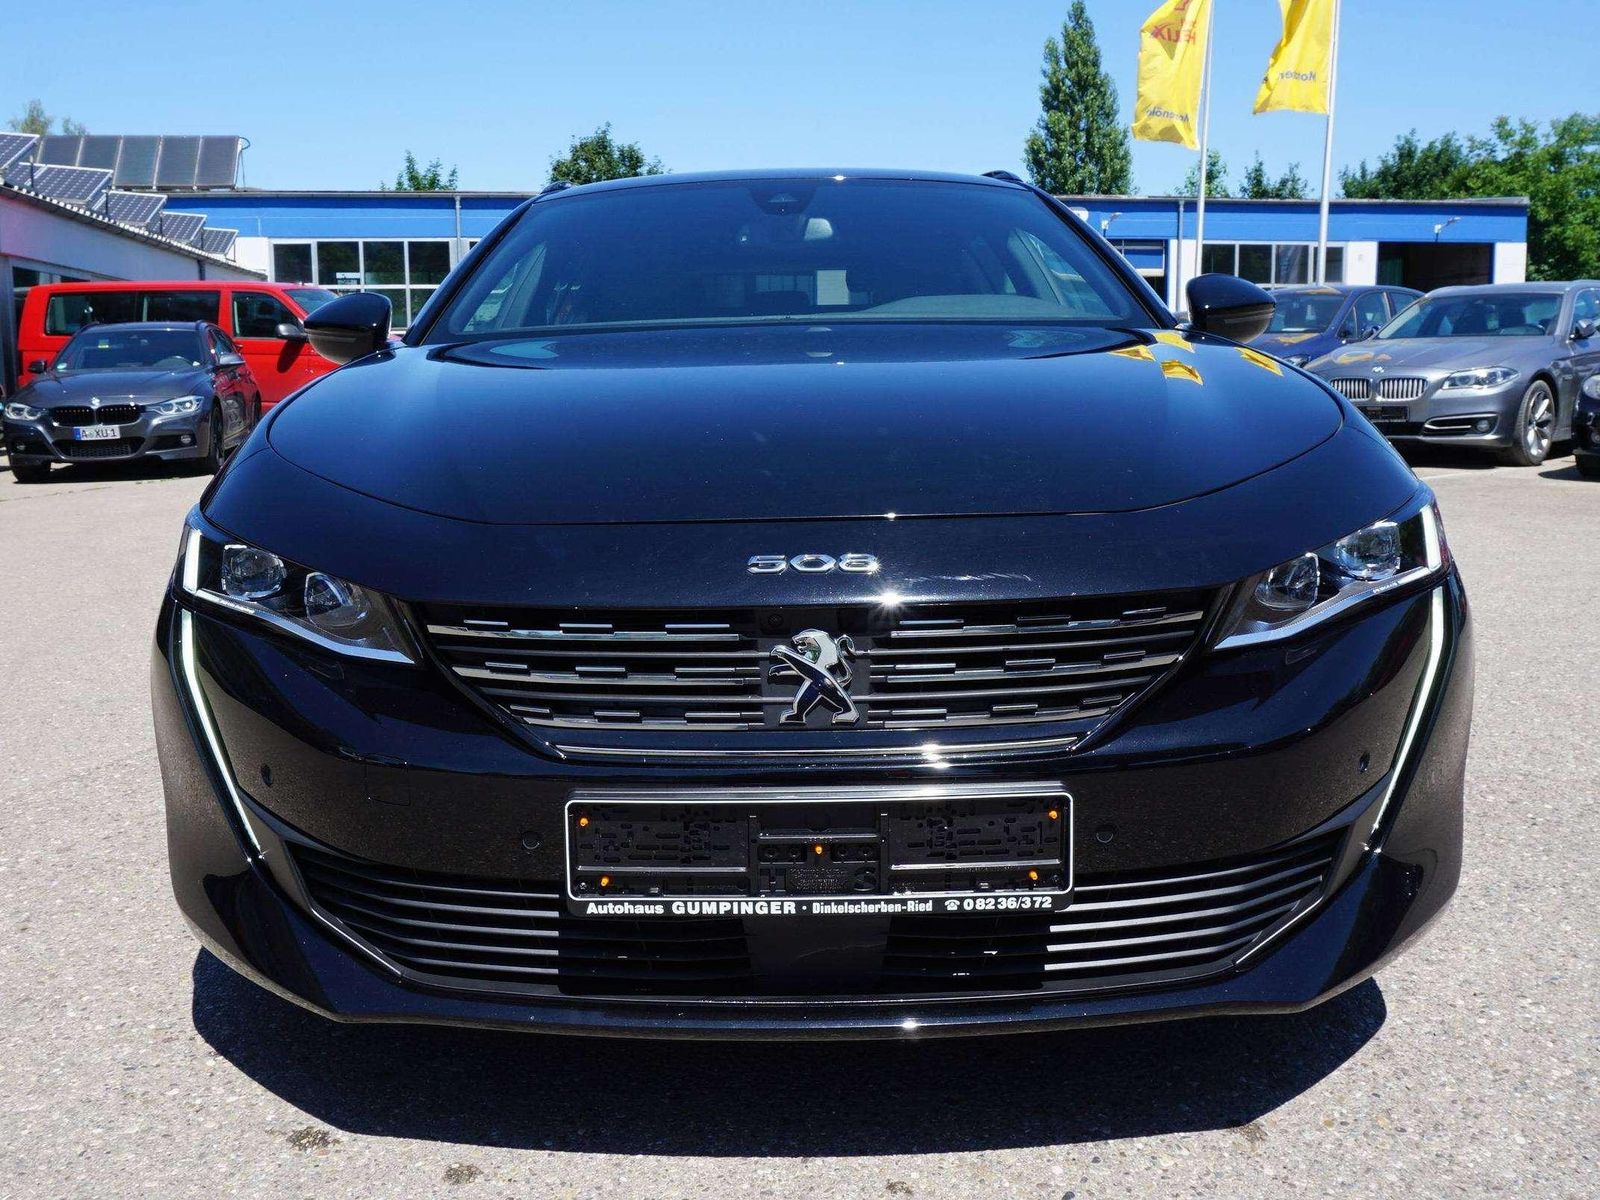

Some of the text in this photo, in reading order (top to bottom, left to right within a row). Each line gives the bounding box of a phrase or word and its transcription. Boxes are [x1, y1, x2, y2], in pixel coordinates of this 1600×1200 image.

[747, 553, 879, 575] 508
[586, 902, 665, 915] Autohaus
[671, 901, 796, 915] GUMPINGER
[812, 899, 933, 914] Dinkelscherben-Ried
